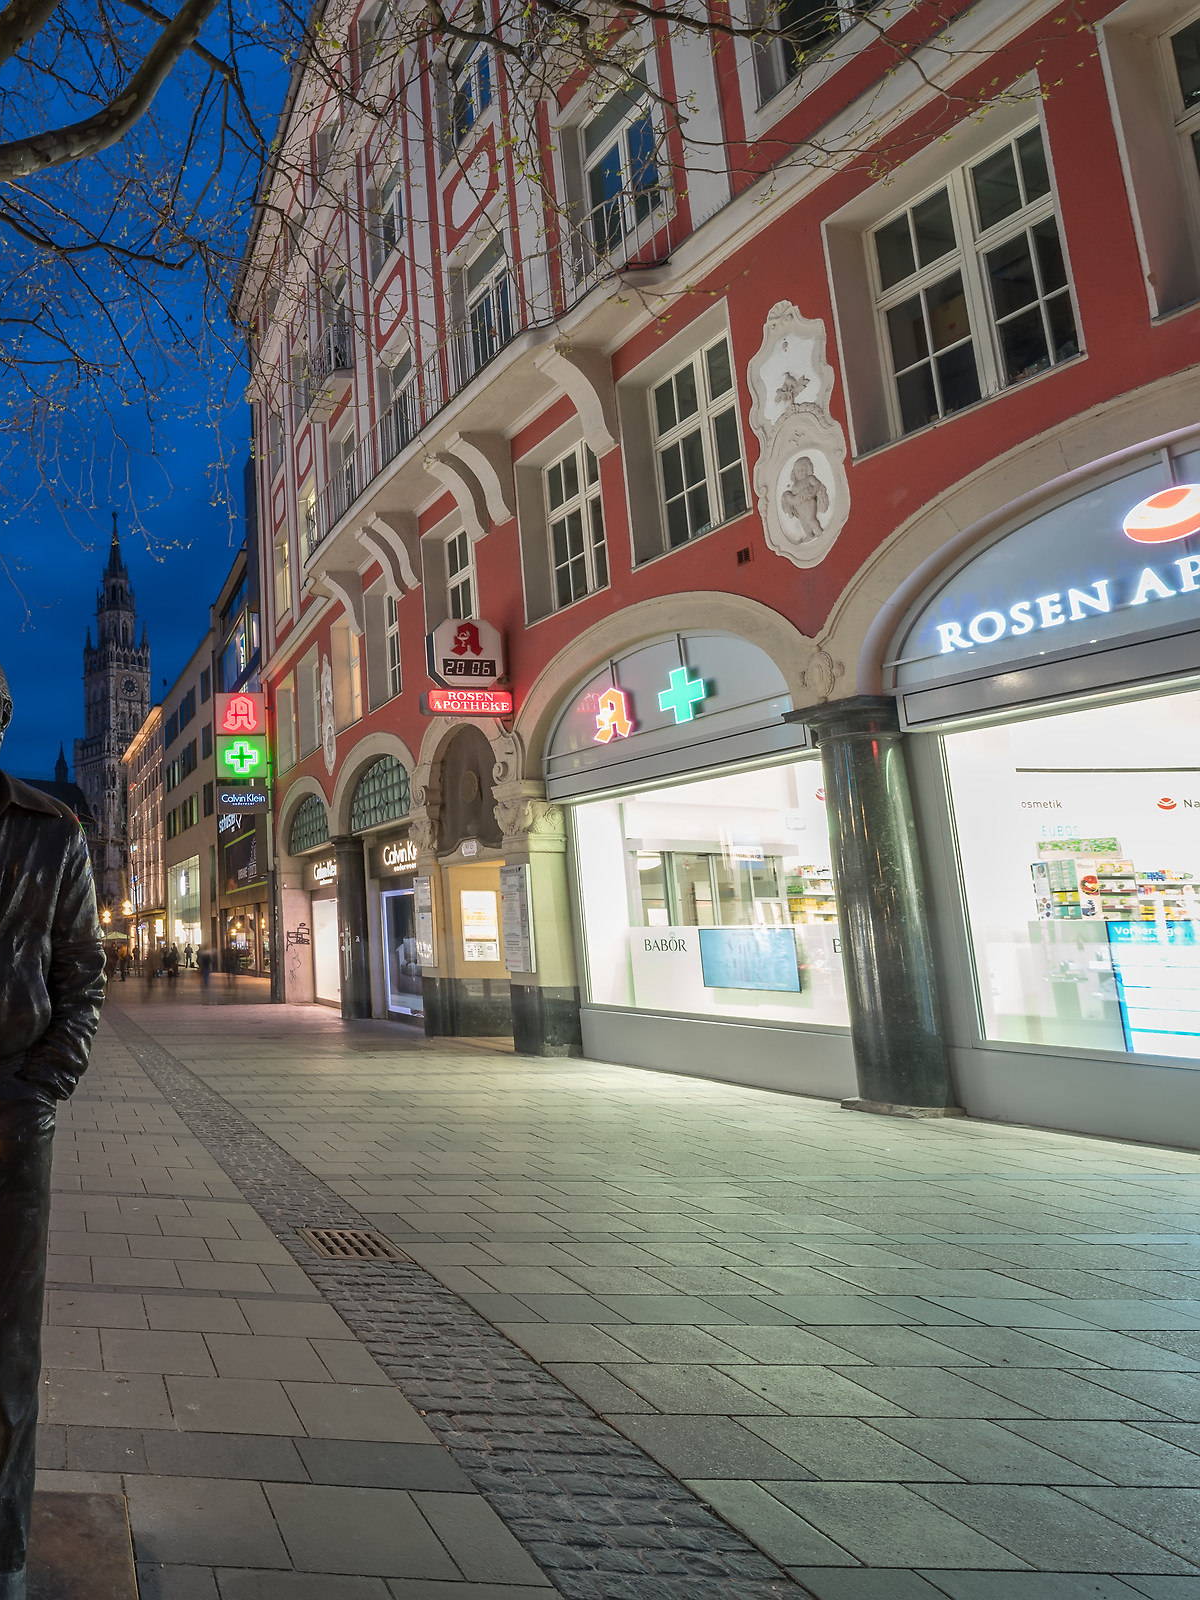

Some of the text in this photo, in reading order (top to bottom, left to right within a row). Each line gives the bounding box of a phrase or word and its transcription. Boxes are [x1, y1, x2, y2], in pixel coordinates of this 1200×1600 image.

[936, 579, 1111, 654] ROSEN
[445, 660, 491, 675] 20 06
[447, 691, 494, 701] ROSEN
[433, 700, 510, 711] APOTHEKE
[221, 793, 266, 803] Calvin Klein
[1020, 799, 1063, 809] osmetik
[383, 842, 407, 866] Calvin
